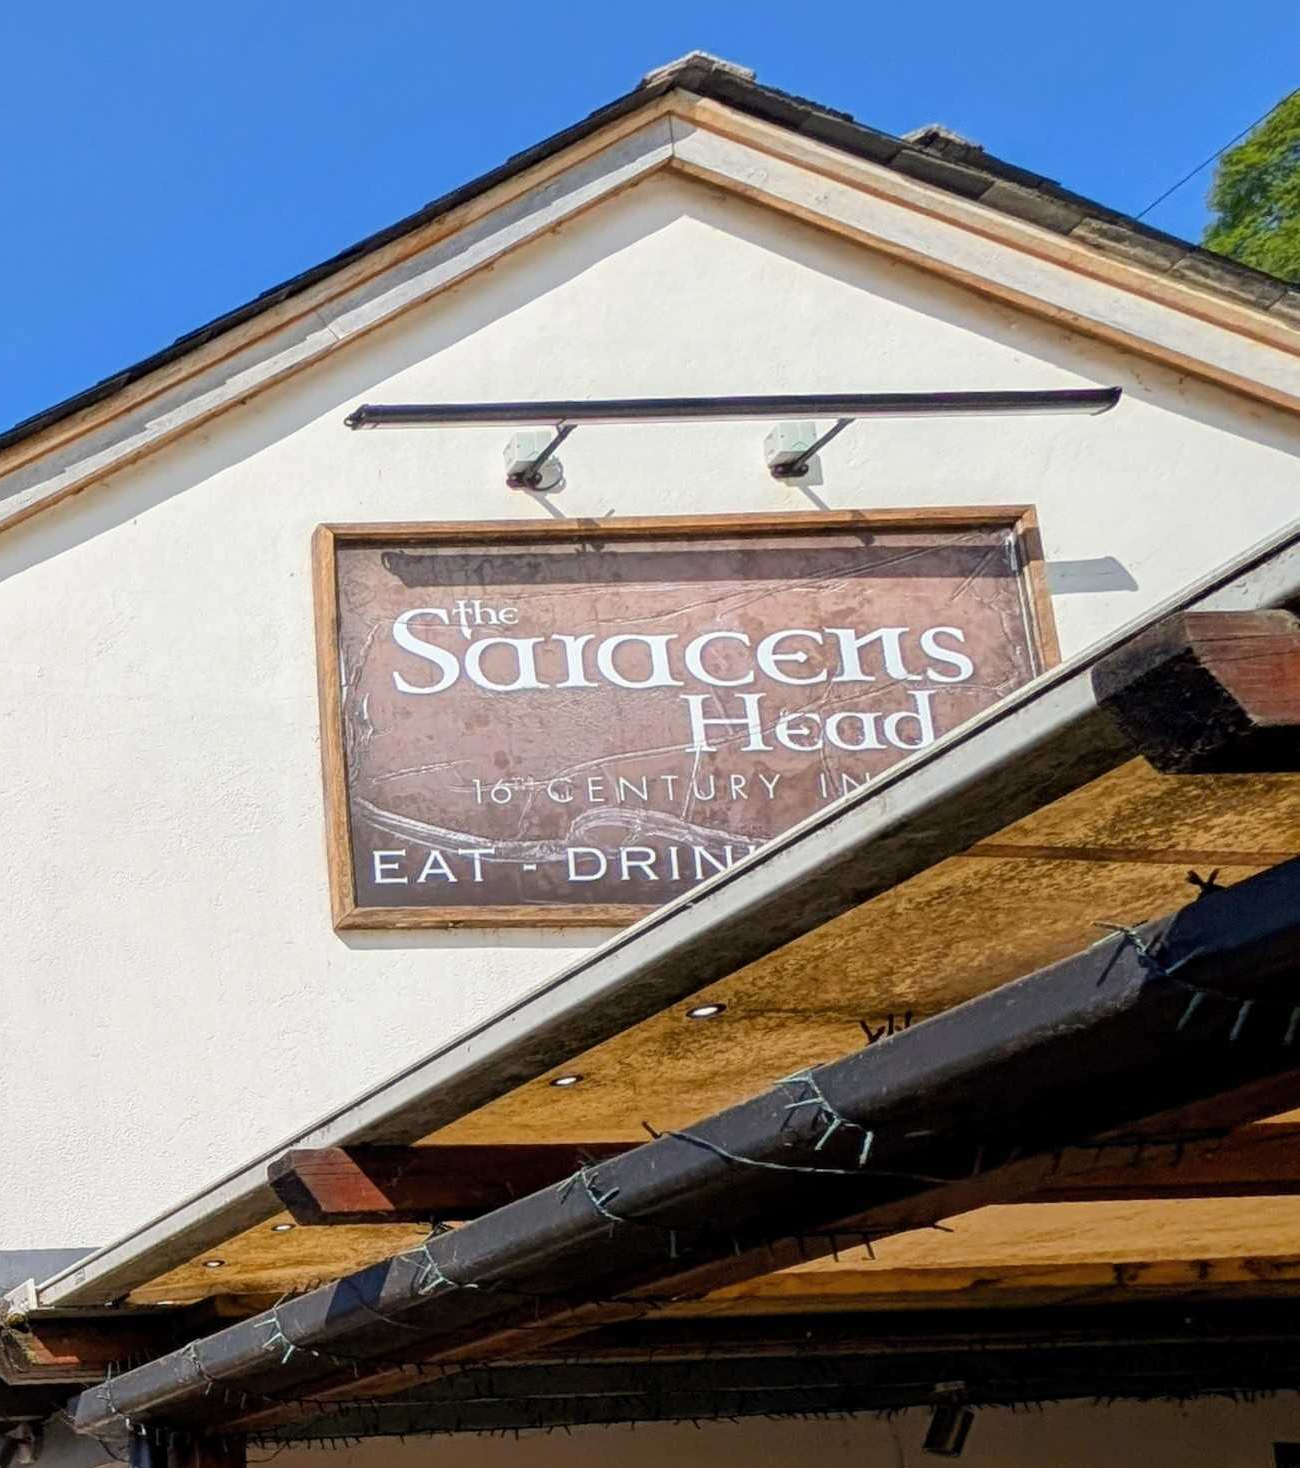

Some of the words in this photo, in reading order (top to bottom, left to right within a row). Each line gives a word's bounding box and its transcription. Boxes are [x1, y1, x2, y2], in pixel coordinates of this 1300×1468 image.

[452, 600, 518, 641] the
[391, 606, 975, 695] Saracens
[680, 689, 938, 753] Head
[546, 773, 781, 803] CENTURY
[372, 847, 495, 885] EAT
[566, 844, 756, 882] DRIN
